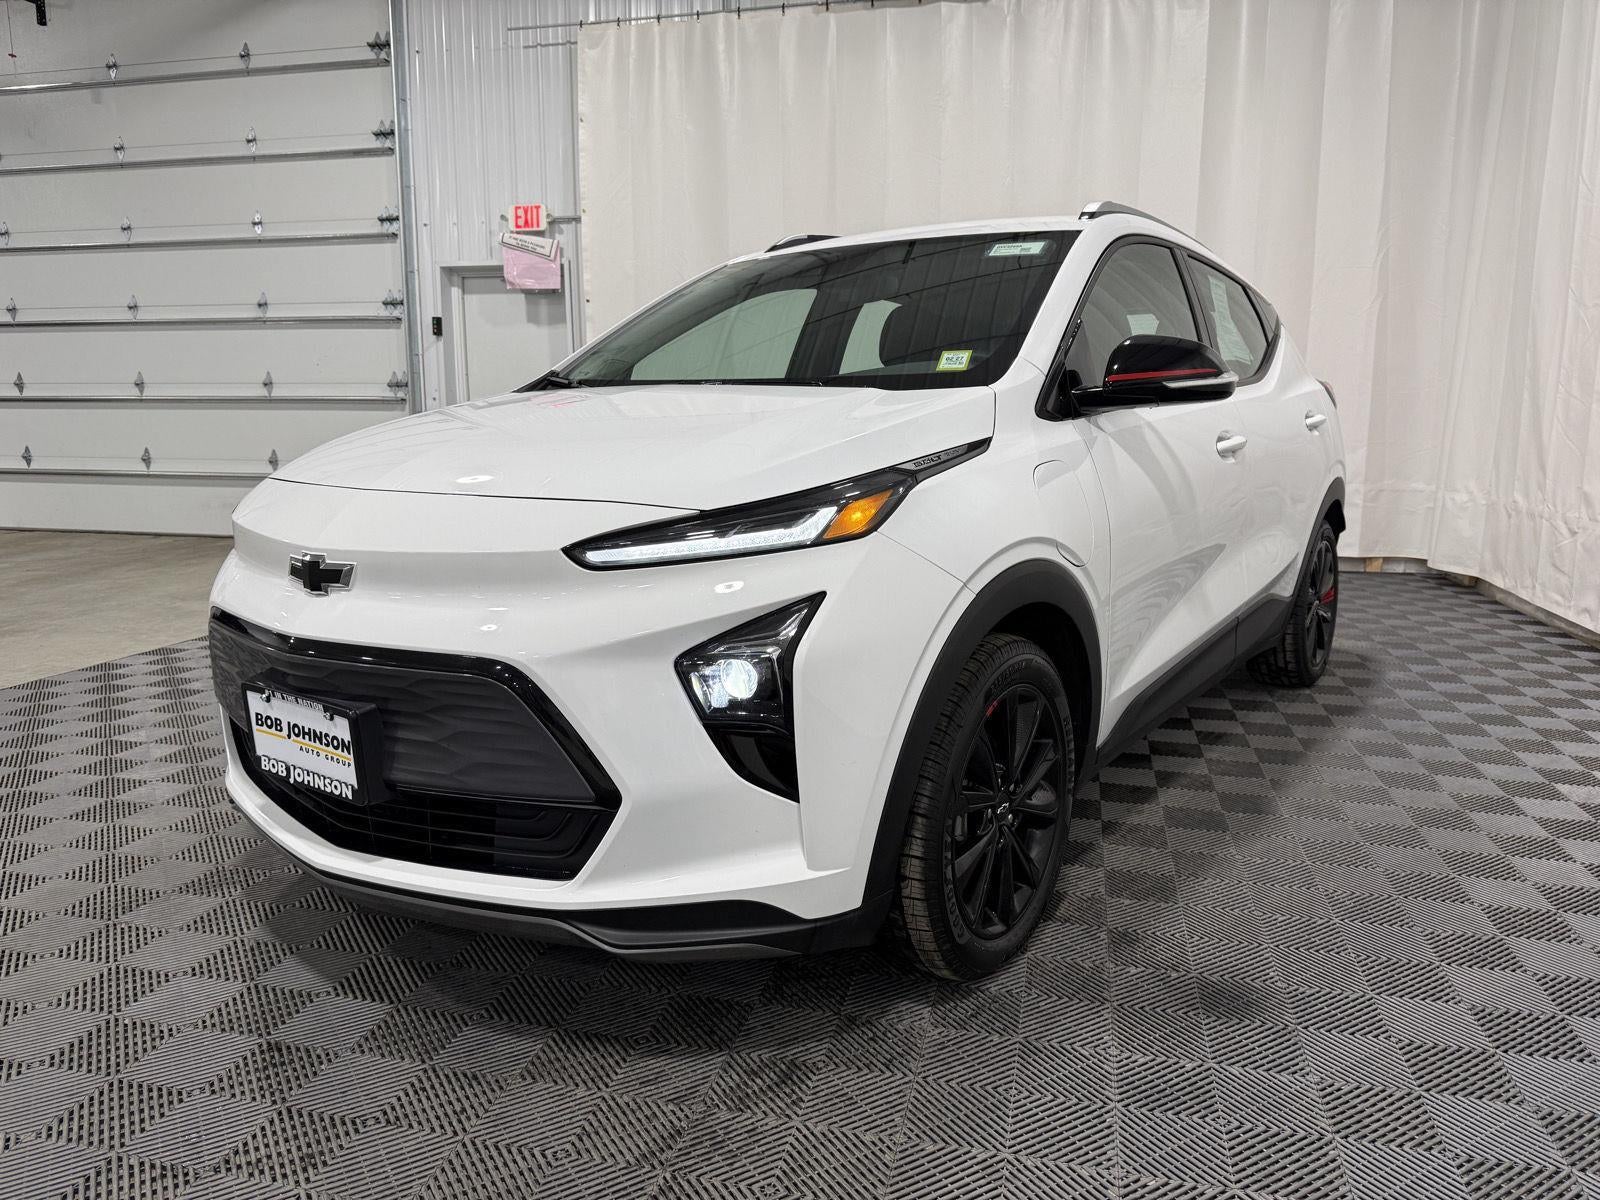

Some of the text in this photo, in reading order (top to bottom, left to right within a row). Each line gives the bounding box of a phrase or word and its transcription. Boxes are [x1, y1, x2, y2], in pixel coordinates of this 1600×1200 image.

[514, 205, 541, 229] EXIT
[282, 693, 297, 703] THE
[298, 697, 324, 712] NATION
[255, 712, 351, 755] BOB JOHNSON
[299, 745, 352, 768] AUTO GROUP
[260, 755, 353, 800] BOB JOHNSON
